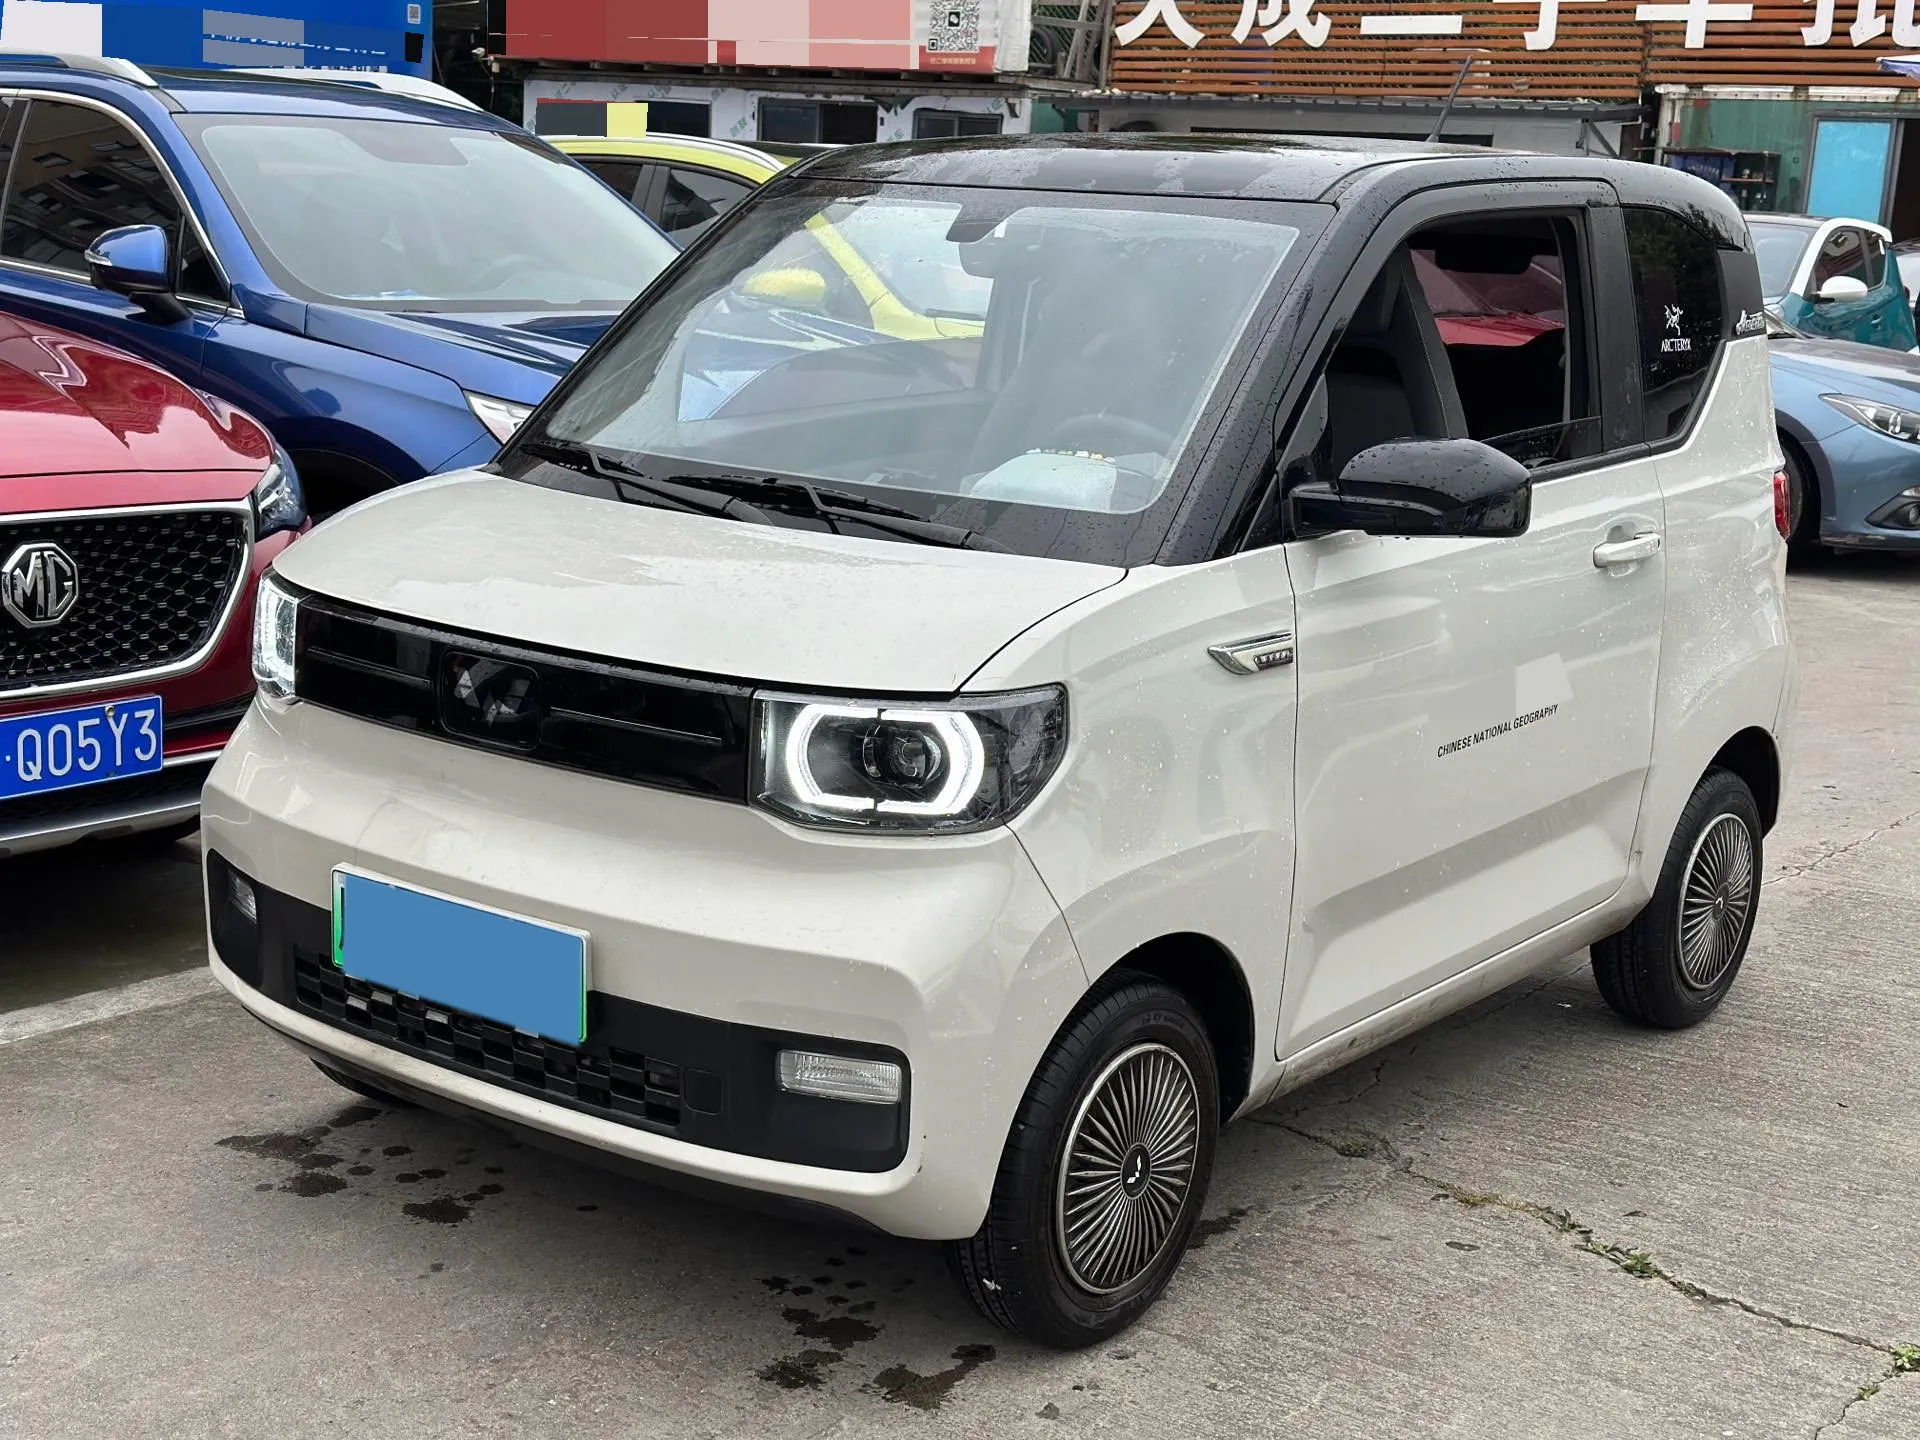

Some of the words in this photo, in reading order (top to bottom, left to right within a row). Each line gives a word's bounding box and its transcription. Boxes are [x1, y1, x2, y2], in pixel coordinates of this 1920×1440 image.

[13, 551, 73, 618] MG
[1437, 735, 1472, 758] CHINESE
[1472, 721, 1512, 745] NATIONAL
[1513, 703, 1558, 729] GEOGRAPHY
